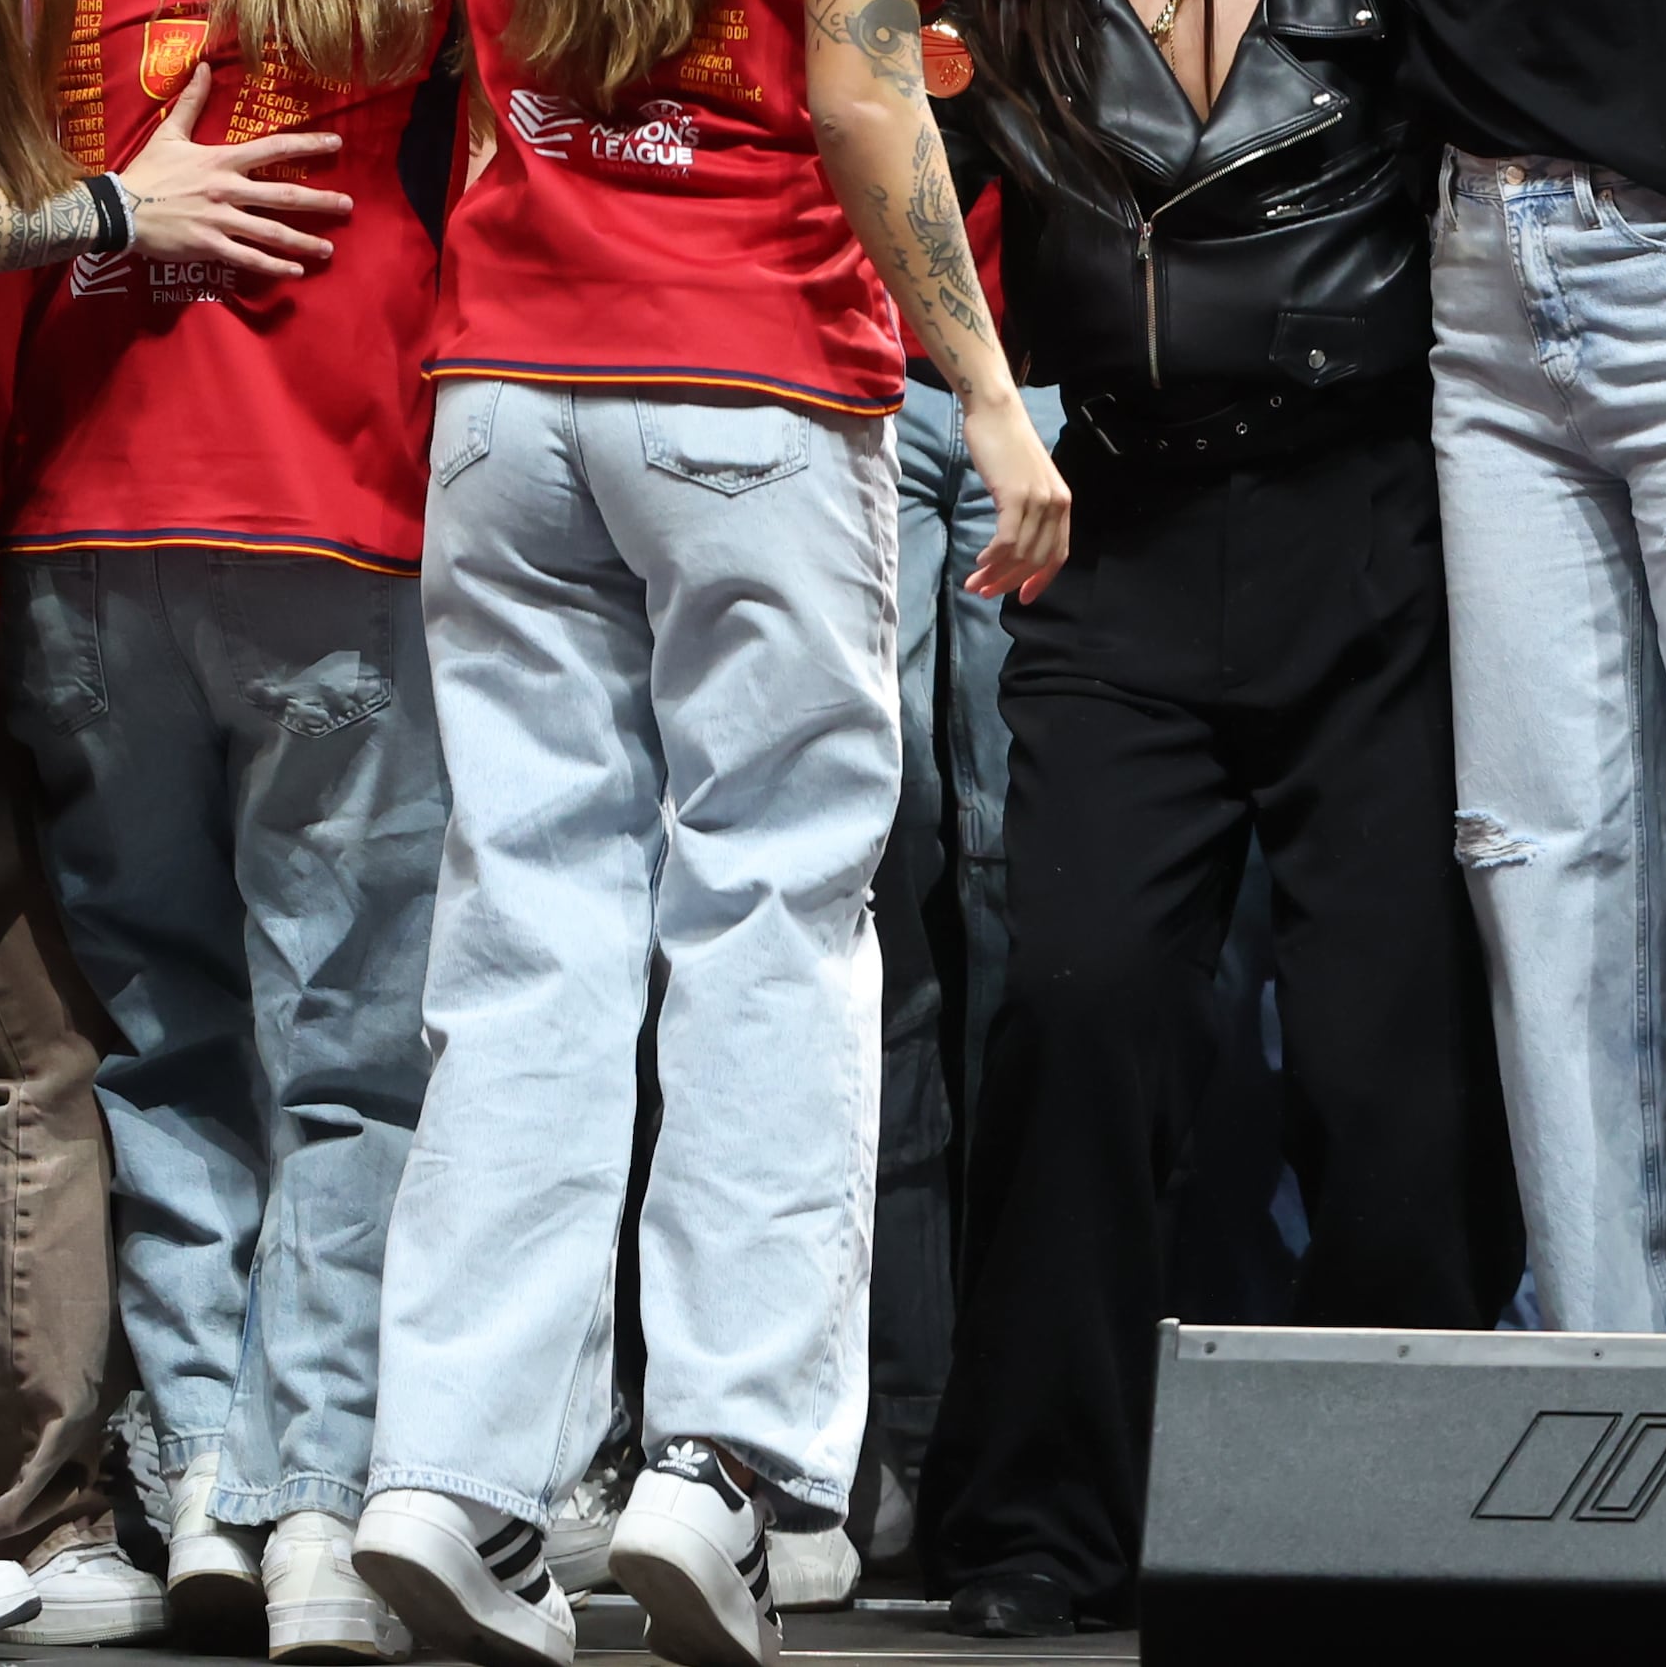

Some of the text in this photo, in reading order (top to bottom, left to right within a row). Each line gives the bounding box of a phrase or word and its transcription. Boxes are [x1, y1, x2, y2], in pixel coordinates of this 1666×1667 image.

[75, 14, 102, 28] NDEZ
[680, 65, 709, 83] CATA
[256, 90, 310, 115] MENDEZ
[68, 117, 105, 133] ESTHER
[229, 115, 264, 134] ROSA
[67, 133, 106, 148] ERMOSO
[591, 136, 694, 166] LEAGUE
[149, 261, 237, 290] LEAGUE
[152, 287, 194, 303] FINALS
[657, 1458, 700, 1477] adidas
